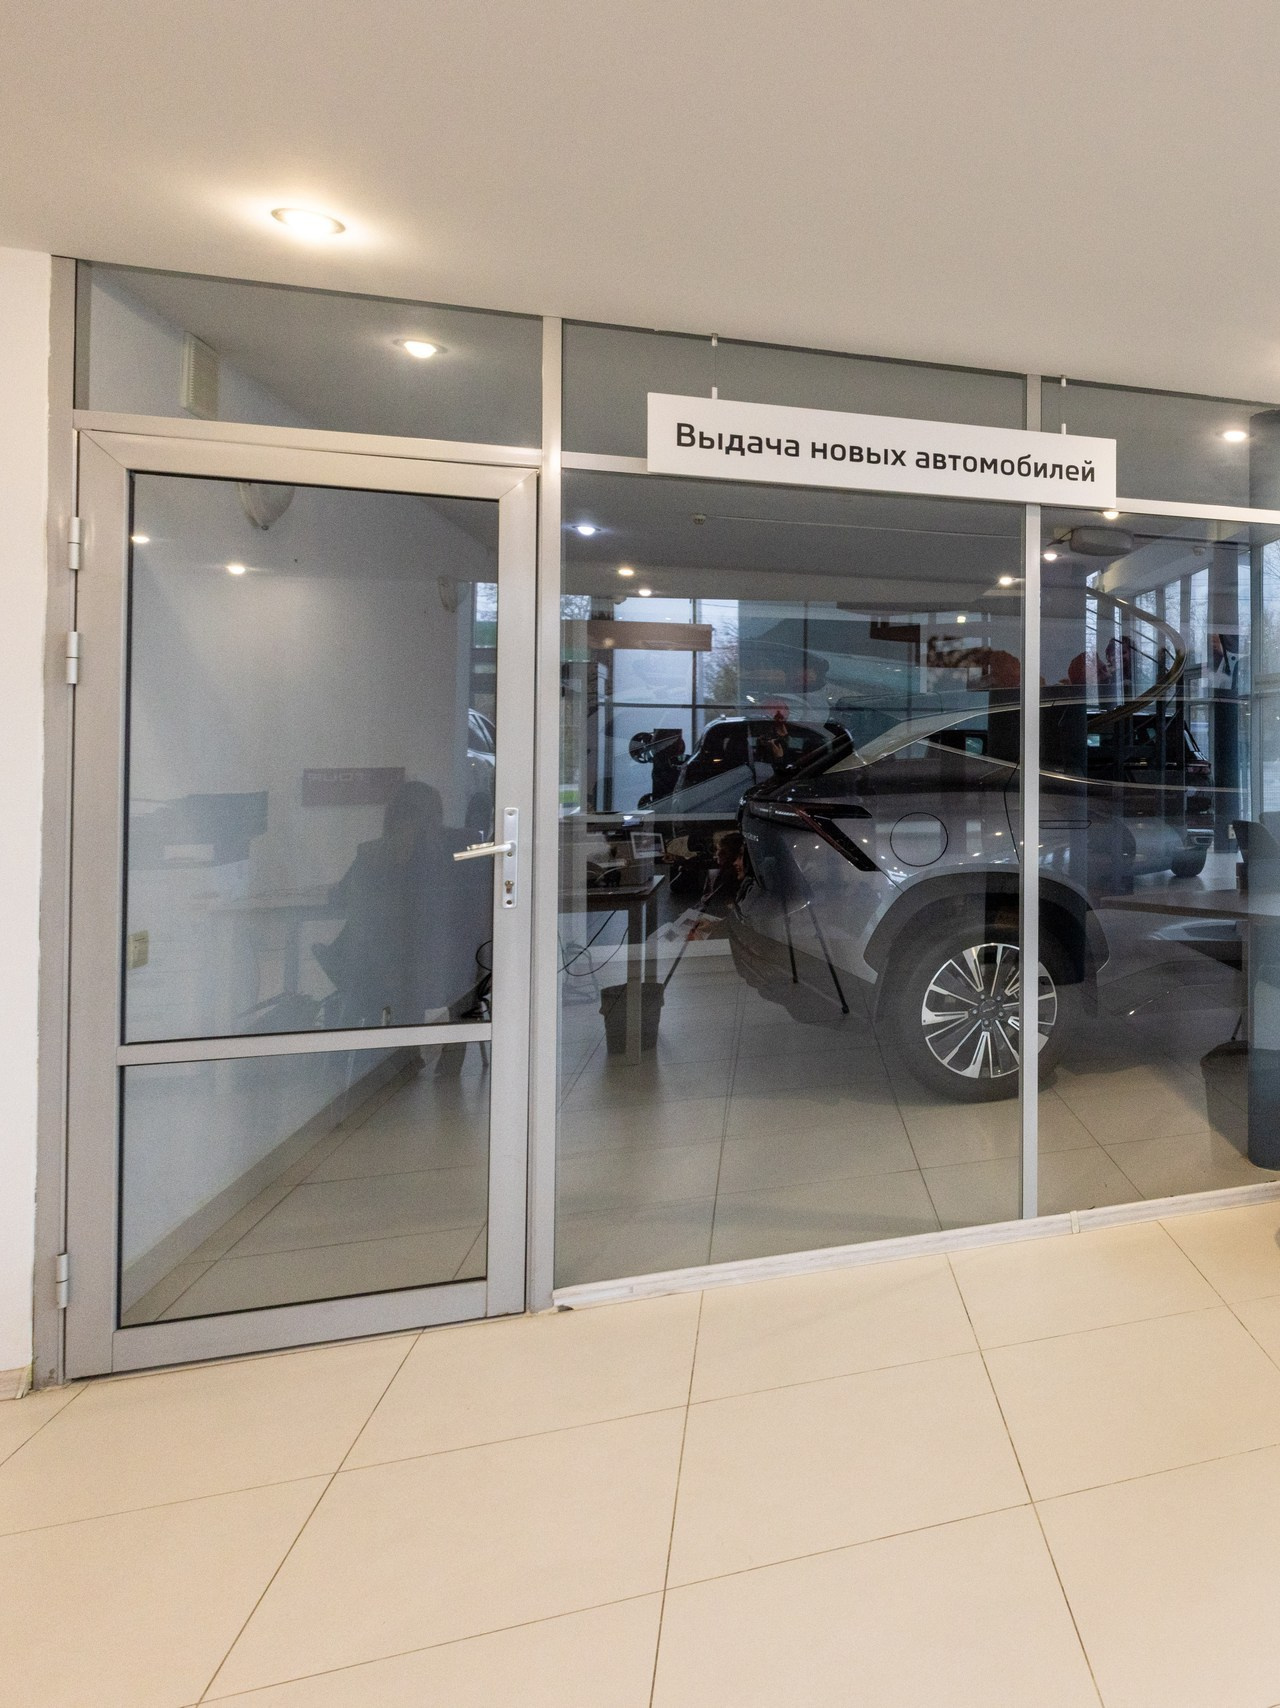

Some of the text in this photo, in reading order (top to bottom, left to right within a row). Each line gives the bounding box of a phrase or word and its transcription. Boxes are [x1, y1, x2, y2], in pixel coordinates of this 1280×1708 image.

[675, 422, 1096, 483] Выдача новых автомобилей
